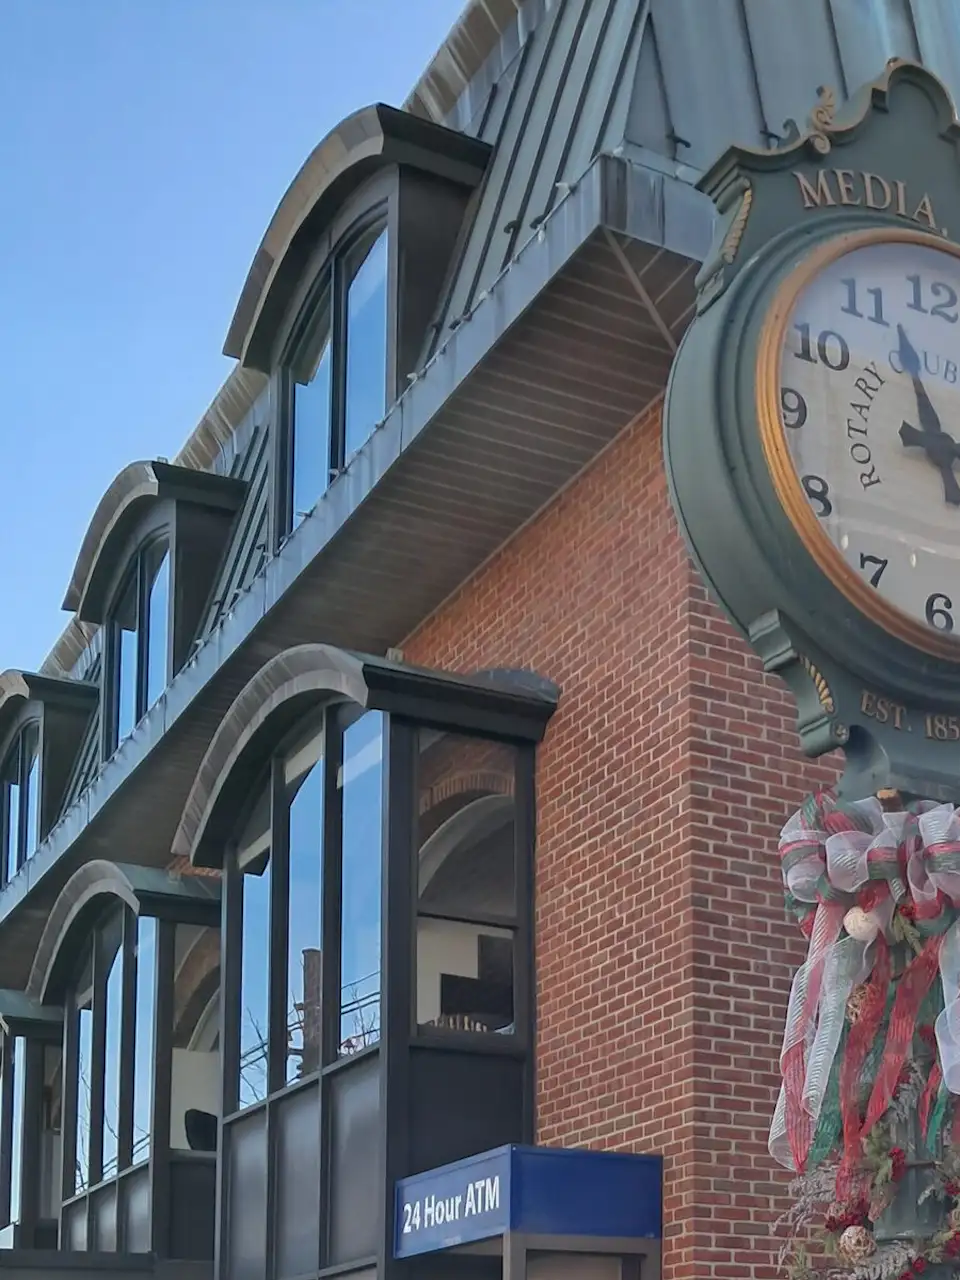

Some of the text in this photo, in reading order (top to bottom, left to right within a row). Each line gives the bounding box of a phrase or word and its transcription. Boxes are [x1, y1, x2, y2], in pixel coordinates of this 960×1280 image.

[840, 277, 890, 327] 11
[906, 274, 959, 324] 12
[793, 322, 850, 371] 10
[781, 387, 808, 429] 9
[846, 361, 886, 490] ROTARY
[888, 349, 958, 384] CUB
[801, 474, 833, 518] 8
[859, 552, 888, 589] 7
[925, 592, 954, 633] 6
[861, 690, 913, 732] EST.
[402, 1175, 500, 1234] 24 Hour ATM
